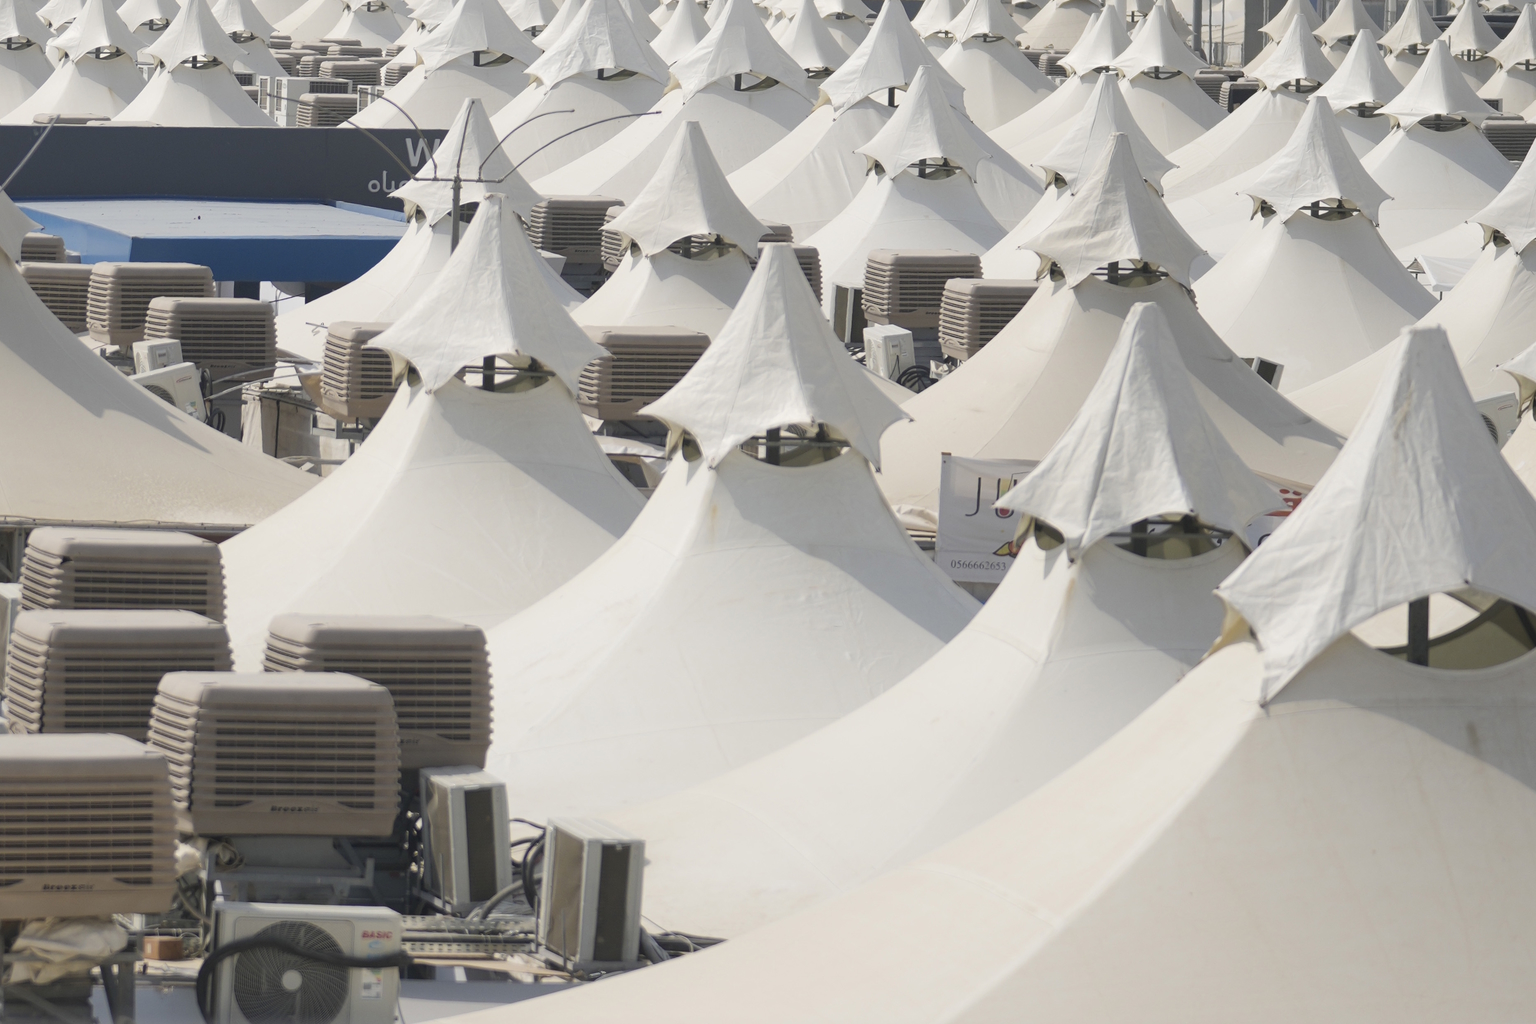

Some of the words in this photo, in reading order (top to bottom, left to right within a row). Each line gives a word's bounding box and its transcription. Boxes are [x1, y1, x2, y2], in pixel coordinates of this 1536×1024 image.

[405, 137, 441, 167] W
[950, 560, 1007, 571] 0566662653
[362, 930, 393, 939] BASIC
